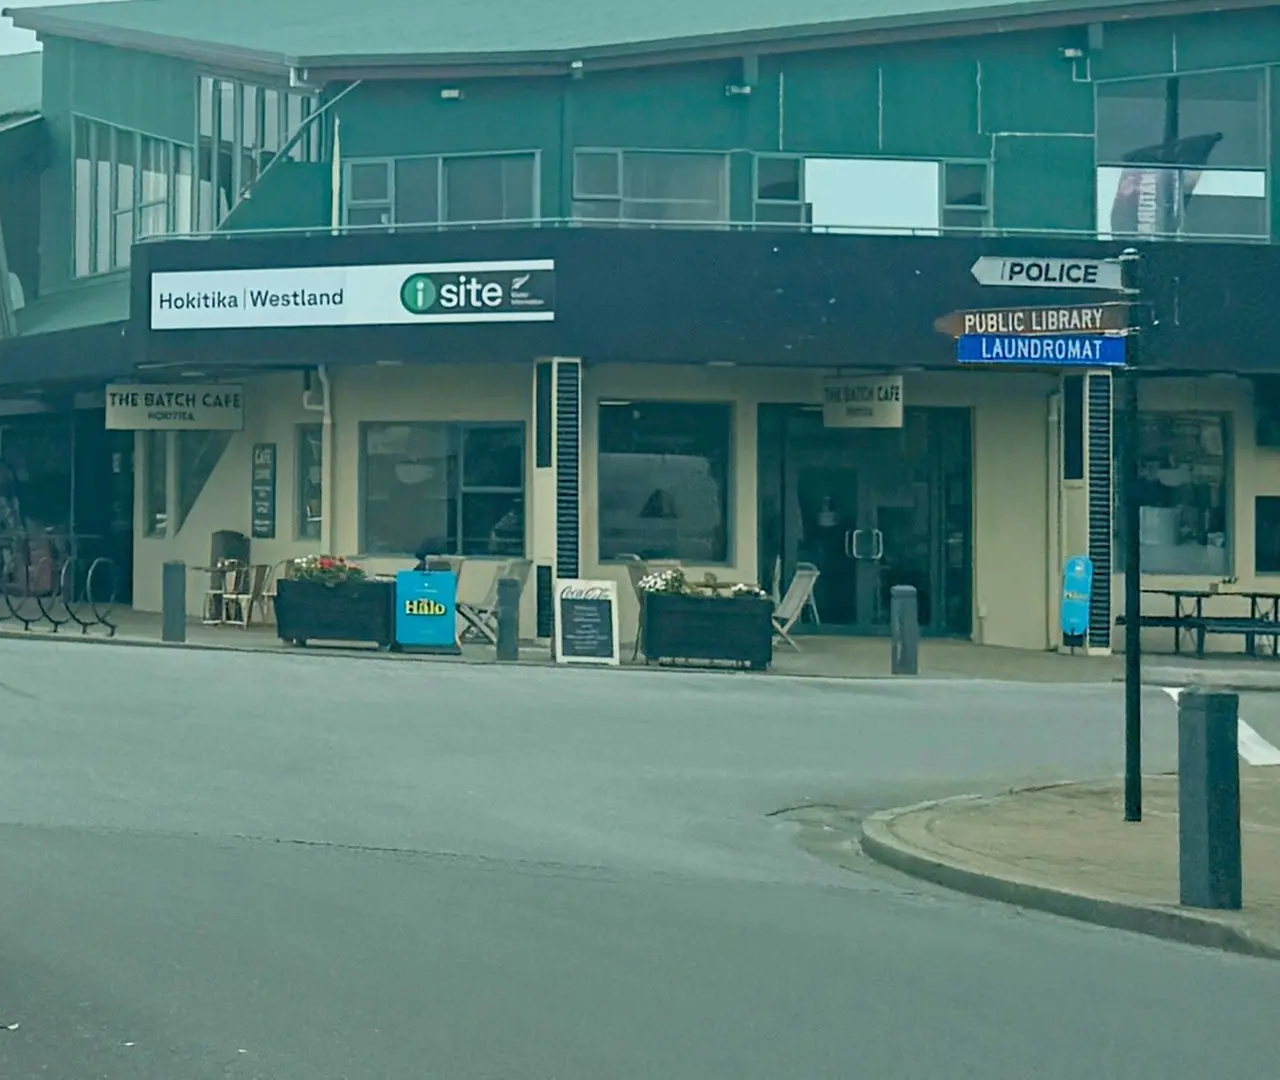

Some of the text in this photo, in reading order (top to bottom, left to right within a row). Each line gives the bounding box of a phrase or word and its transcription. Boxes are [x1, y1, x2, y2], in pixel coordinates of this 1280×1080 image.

[1008, 262, 1098, 284] POLICE
[159, 288, 344, 310] Hokitika Westland
[440, 274, 503, 308] site
[964, 308, 1103, 334] PUBLIC LIBRARY
[981, 337, 1103, 360] LAUNDROMAT
[109, 392, 241, 409] THE BATCH CAFE
